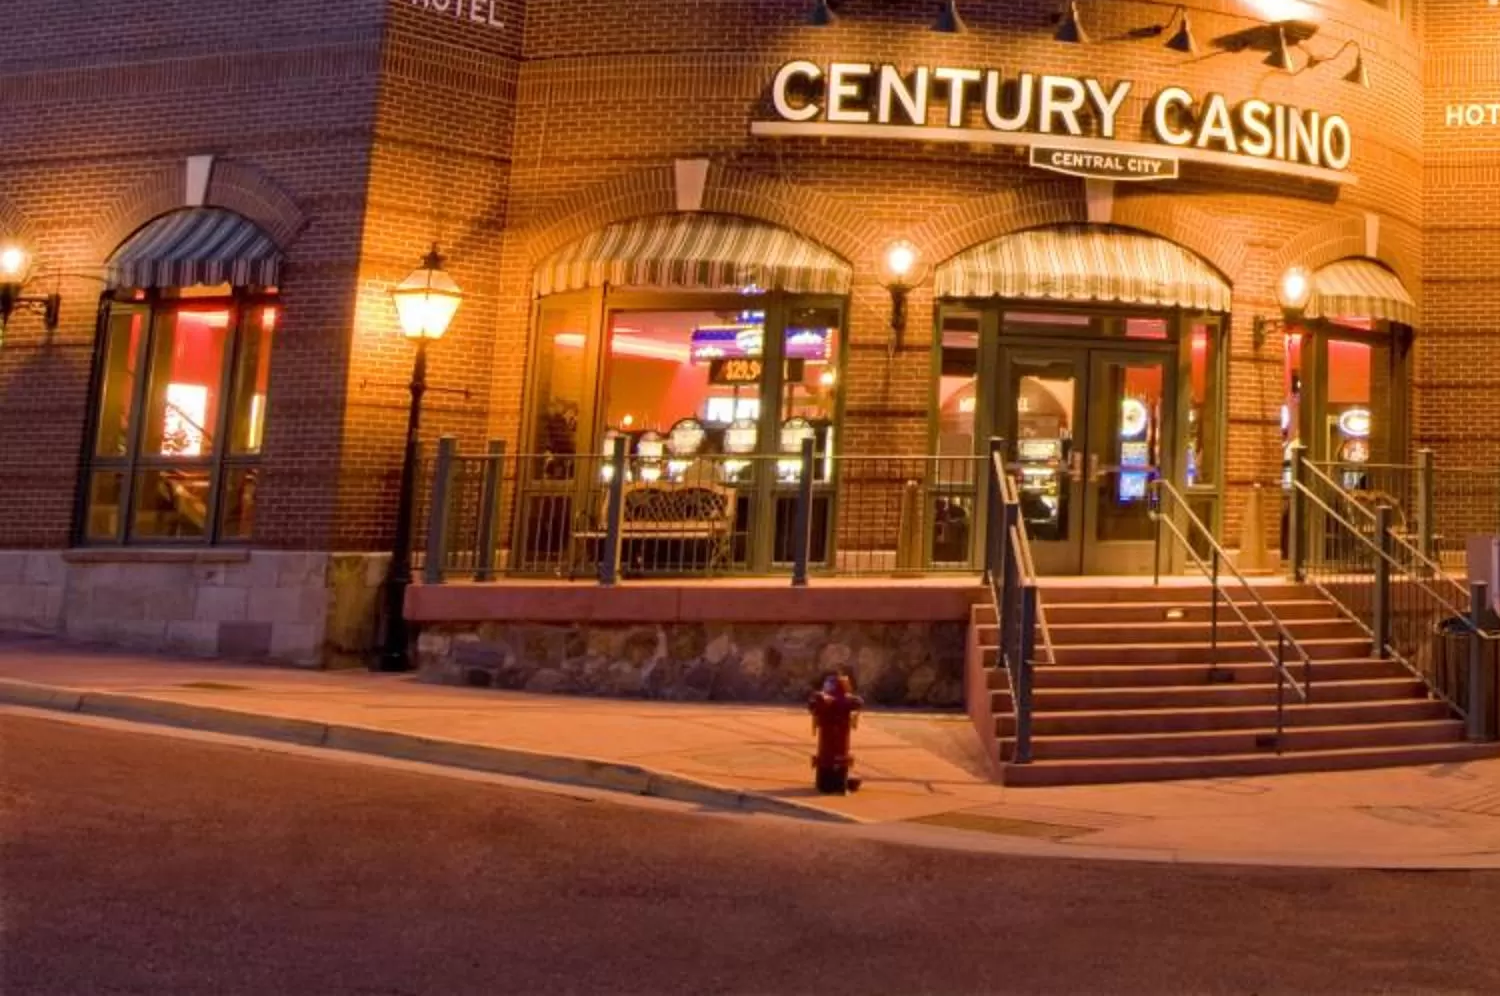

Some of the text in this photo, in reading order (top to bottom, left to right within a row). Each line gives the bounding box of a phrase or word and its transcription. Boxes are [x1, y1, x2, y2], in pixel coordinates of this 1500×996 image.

[771, 61, 1352, 170] CENTURY CASINO
[1052, 152, 1161, 173] CENTRAL CITY
